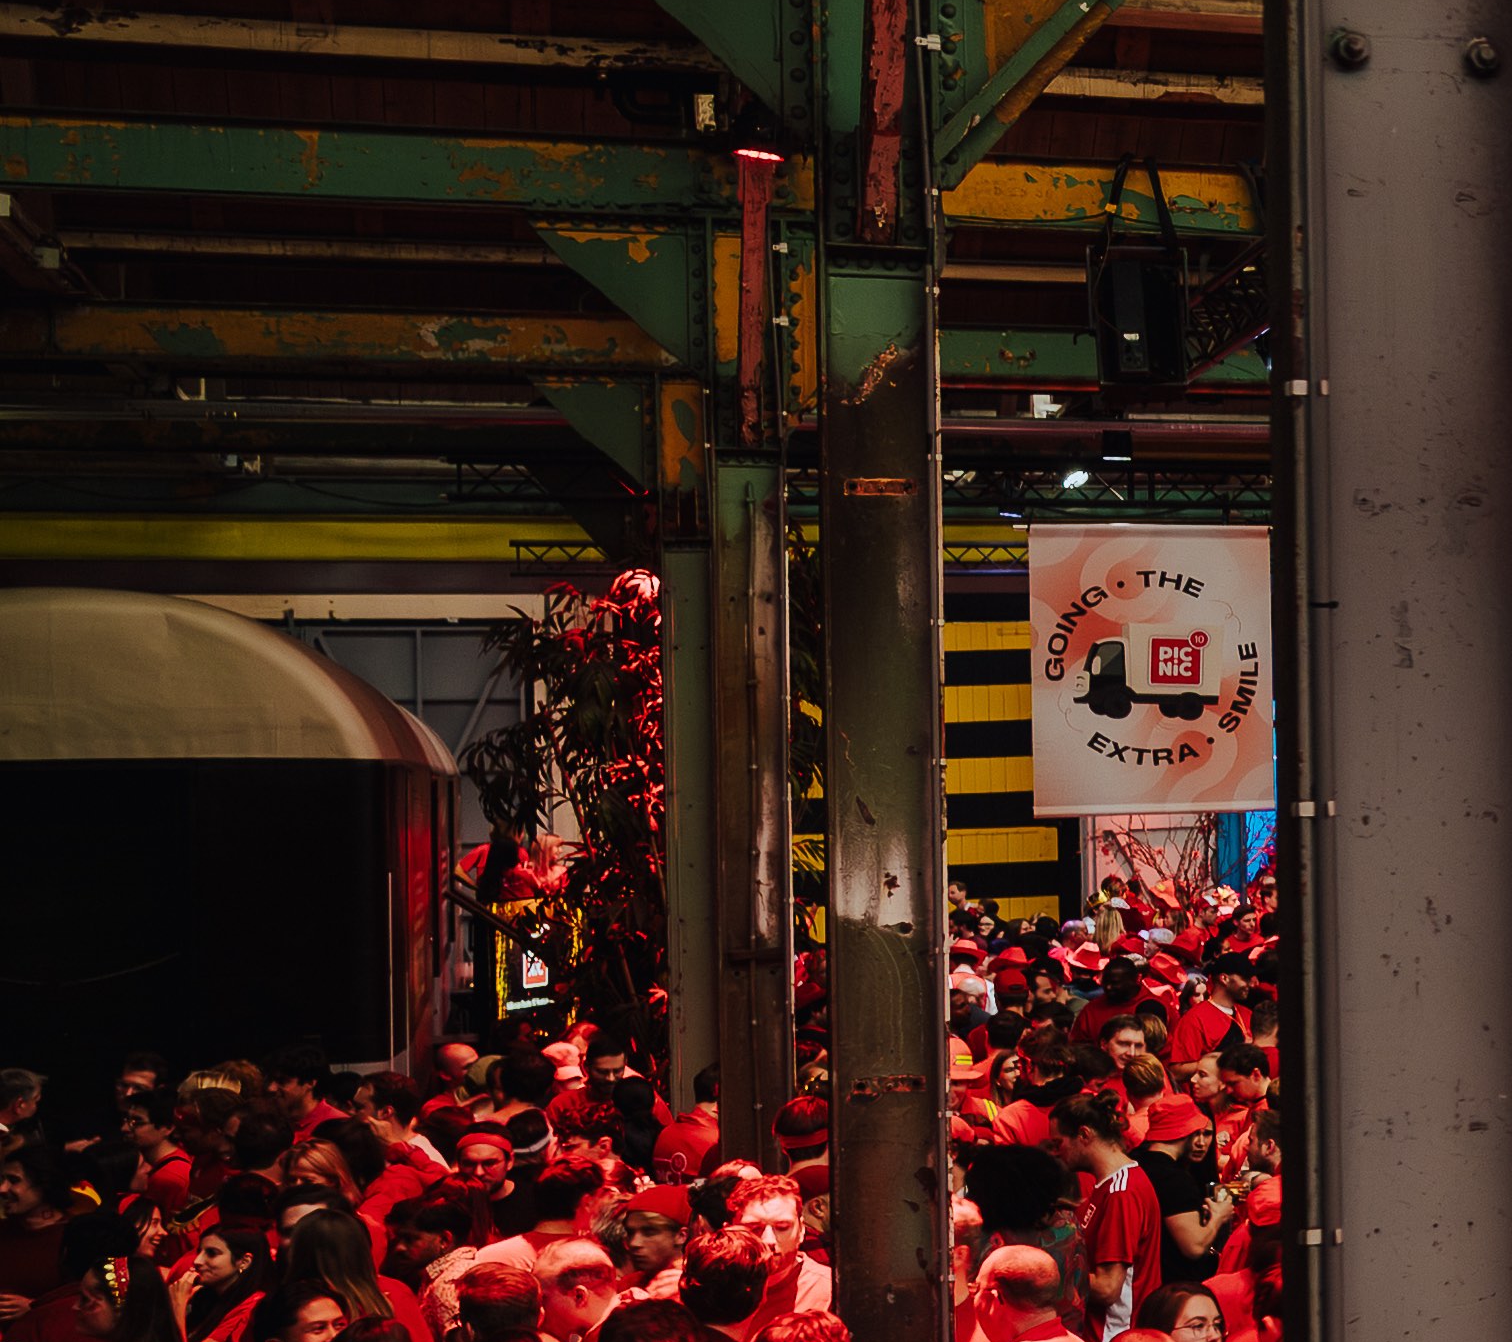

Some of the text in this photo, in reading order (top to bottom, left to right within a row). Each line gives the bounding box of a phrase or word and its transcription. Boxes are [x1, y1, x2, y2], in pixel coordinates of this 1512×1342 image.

[1045, 570, 1205, 681] GOING THE
[1159, 646, 1192, 662] PIC
[1194, 635, 1205, 645] 10
[1087, 642, 1259, 767] EXTRA SMILE
